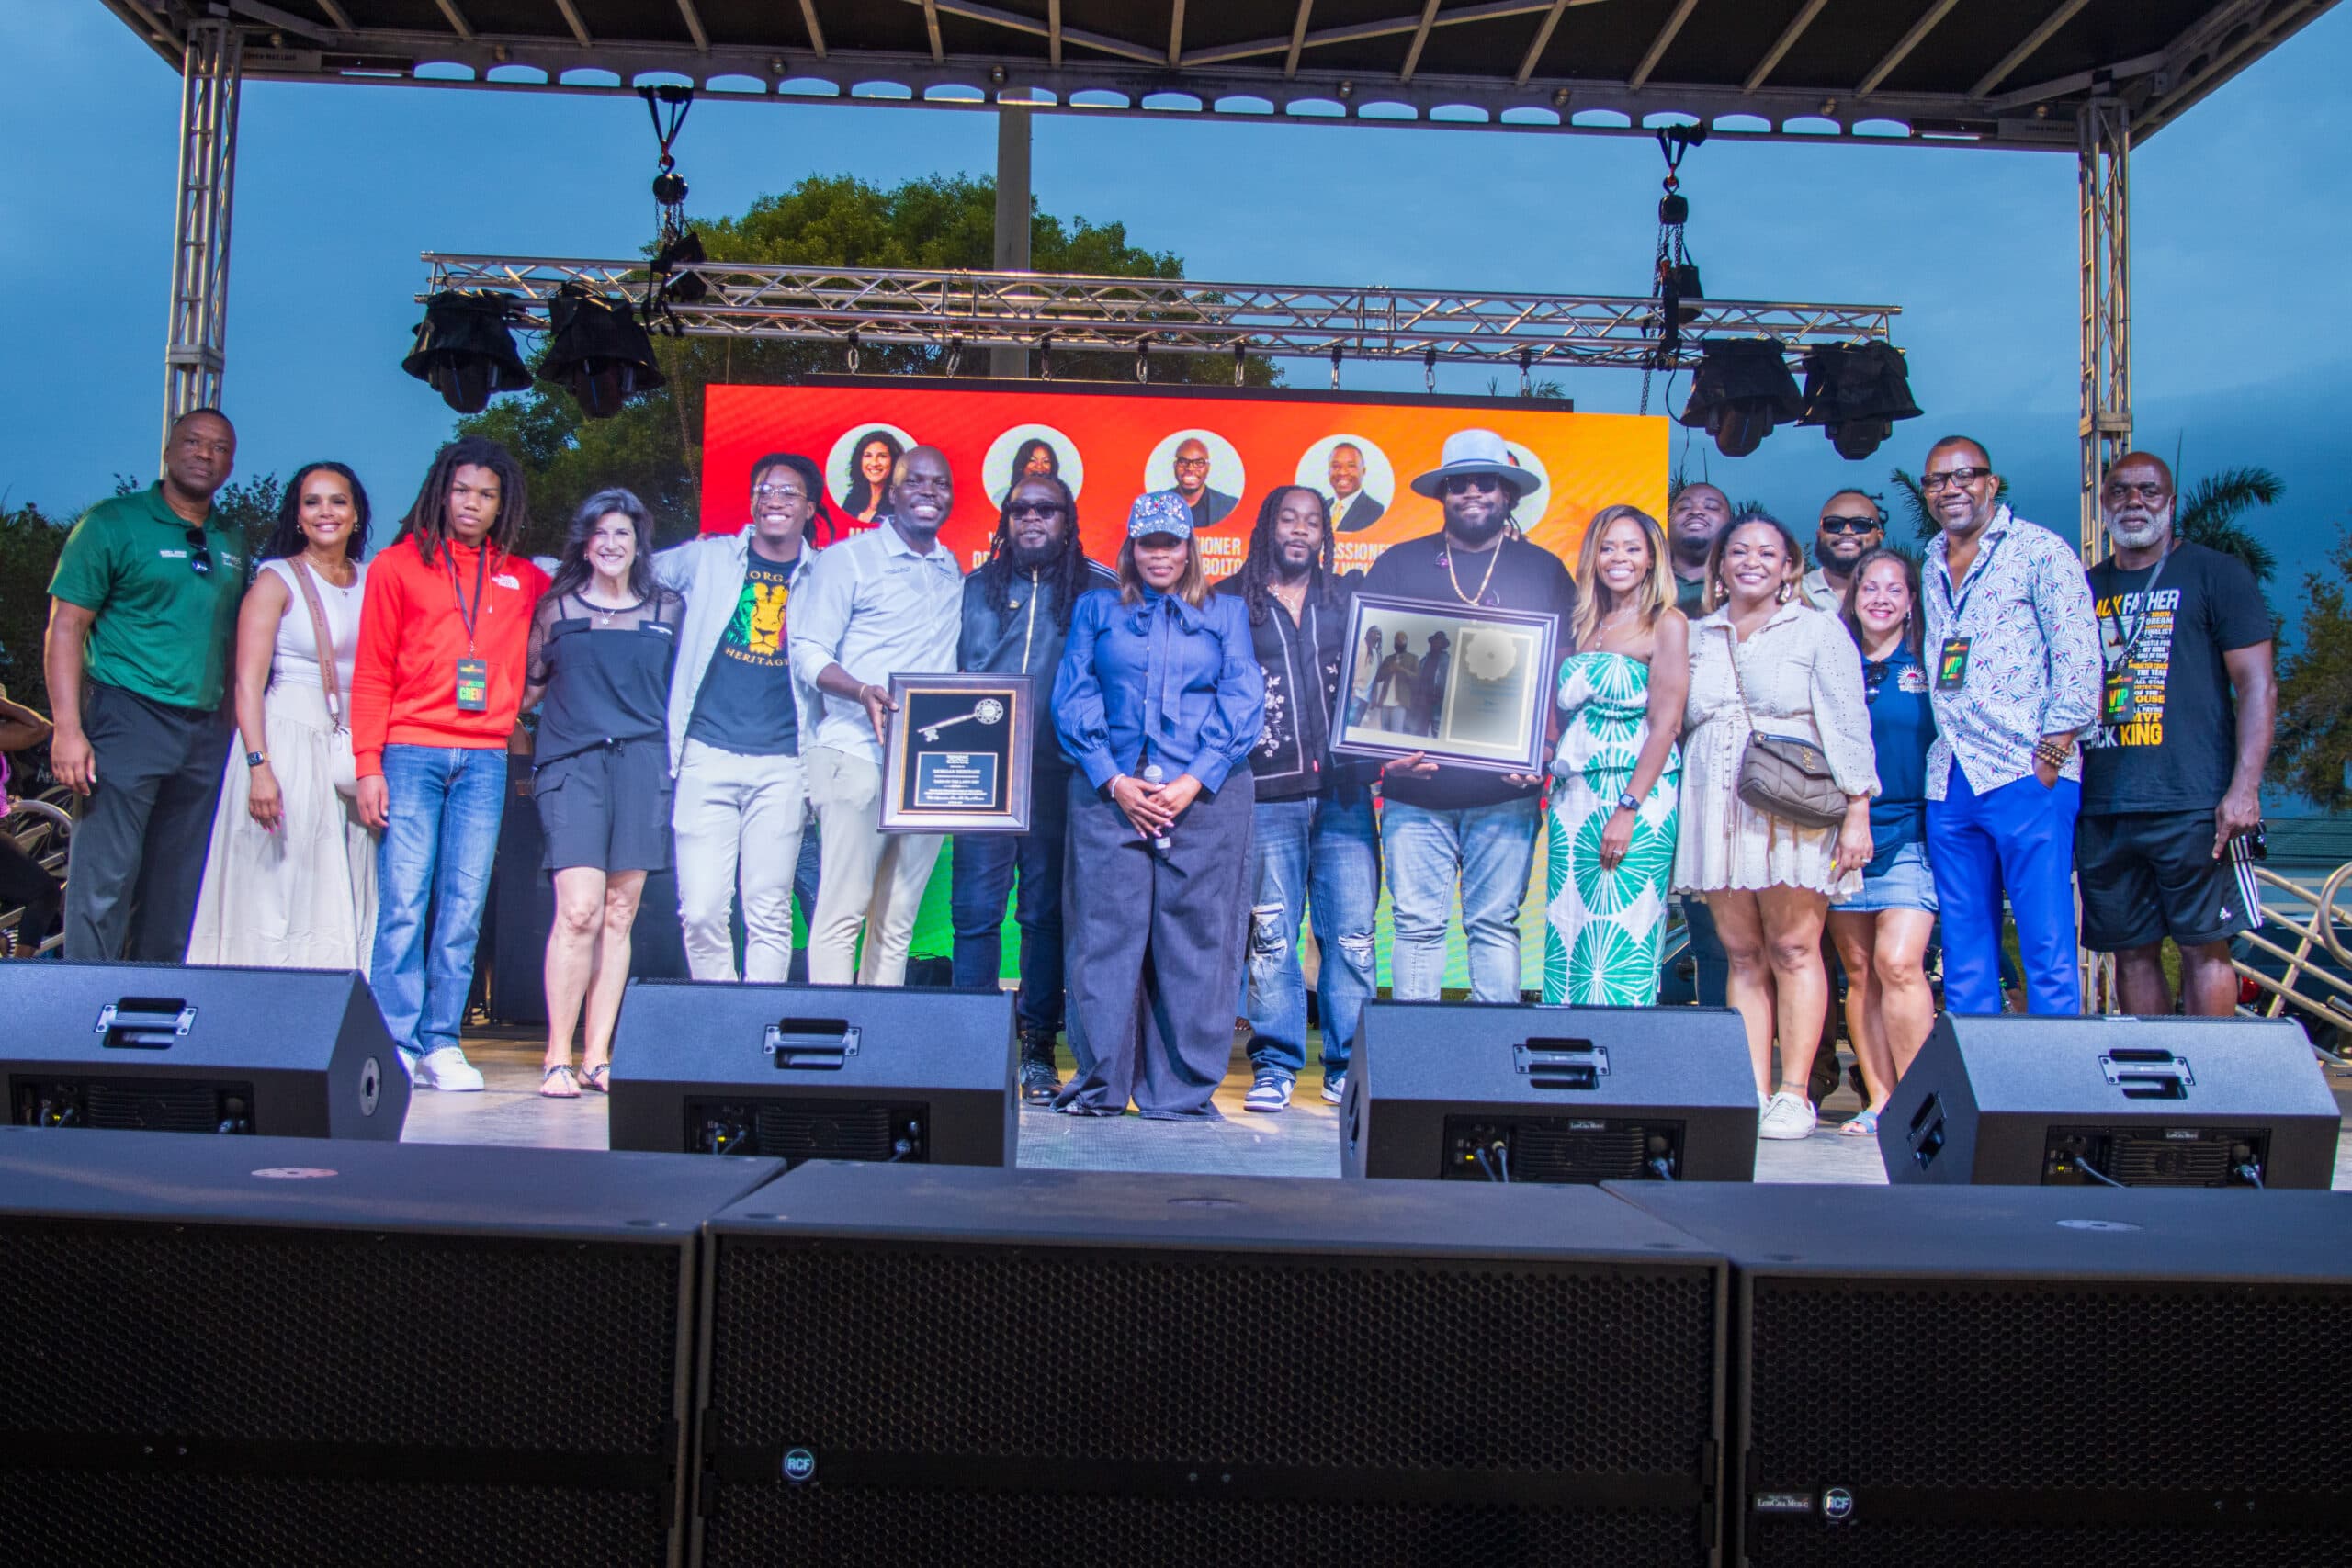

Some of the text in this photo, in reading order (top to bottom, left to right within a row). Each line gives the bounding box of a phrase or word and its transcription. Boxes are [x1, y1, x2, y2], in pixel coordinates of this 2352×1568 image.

[745, 570, 791, 584] ORG
[1944, 656, 1963, 673] VIP
[2109, 688, 2129, 707] VIP
[2120, 722, 2164, 747] KING
[787, 1457, 810, 1471] RCF
[1826, 1496, 1849, 1509] RCF
